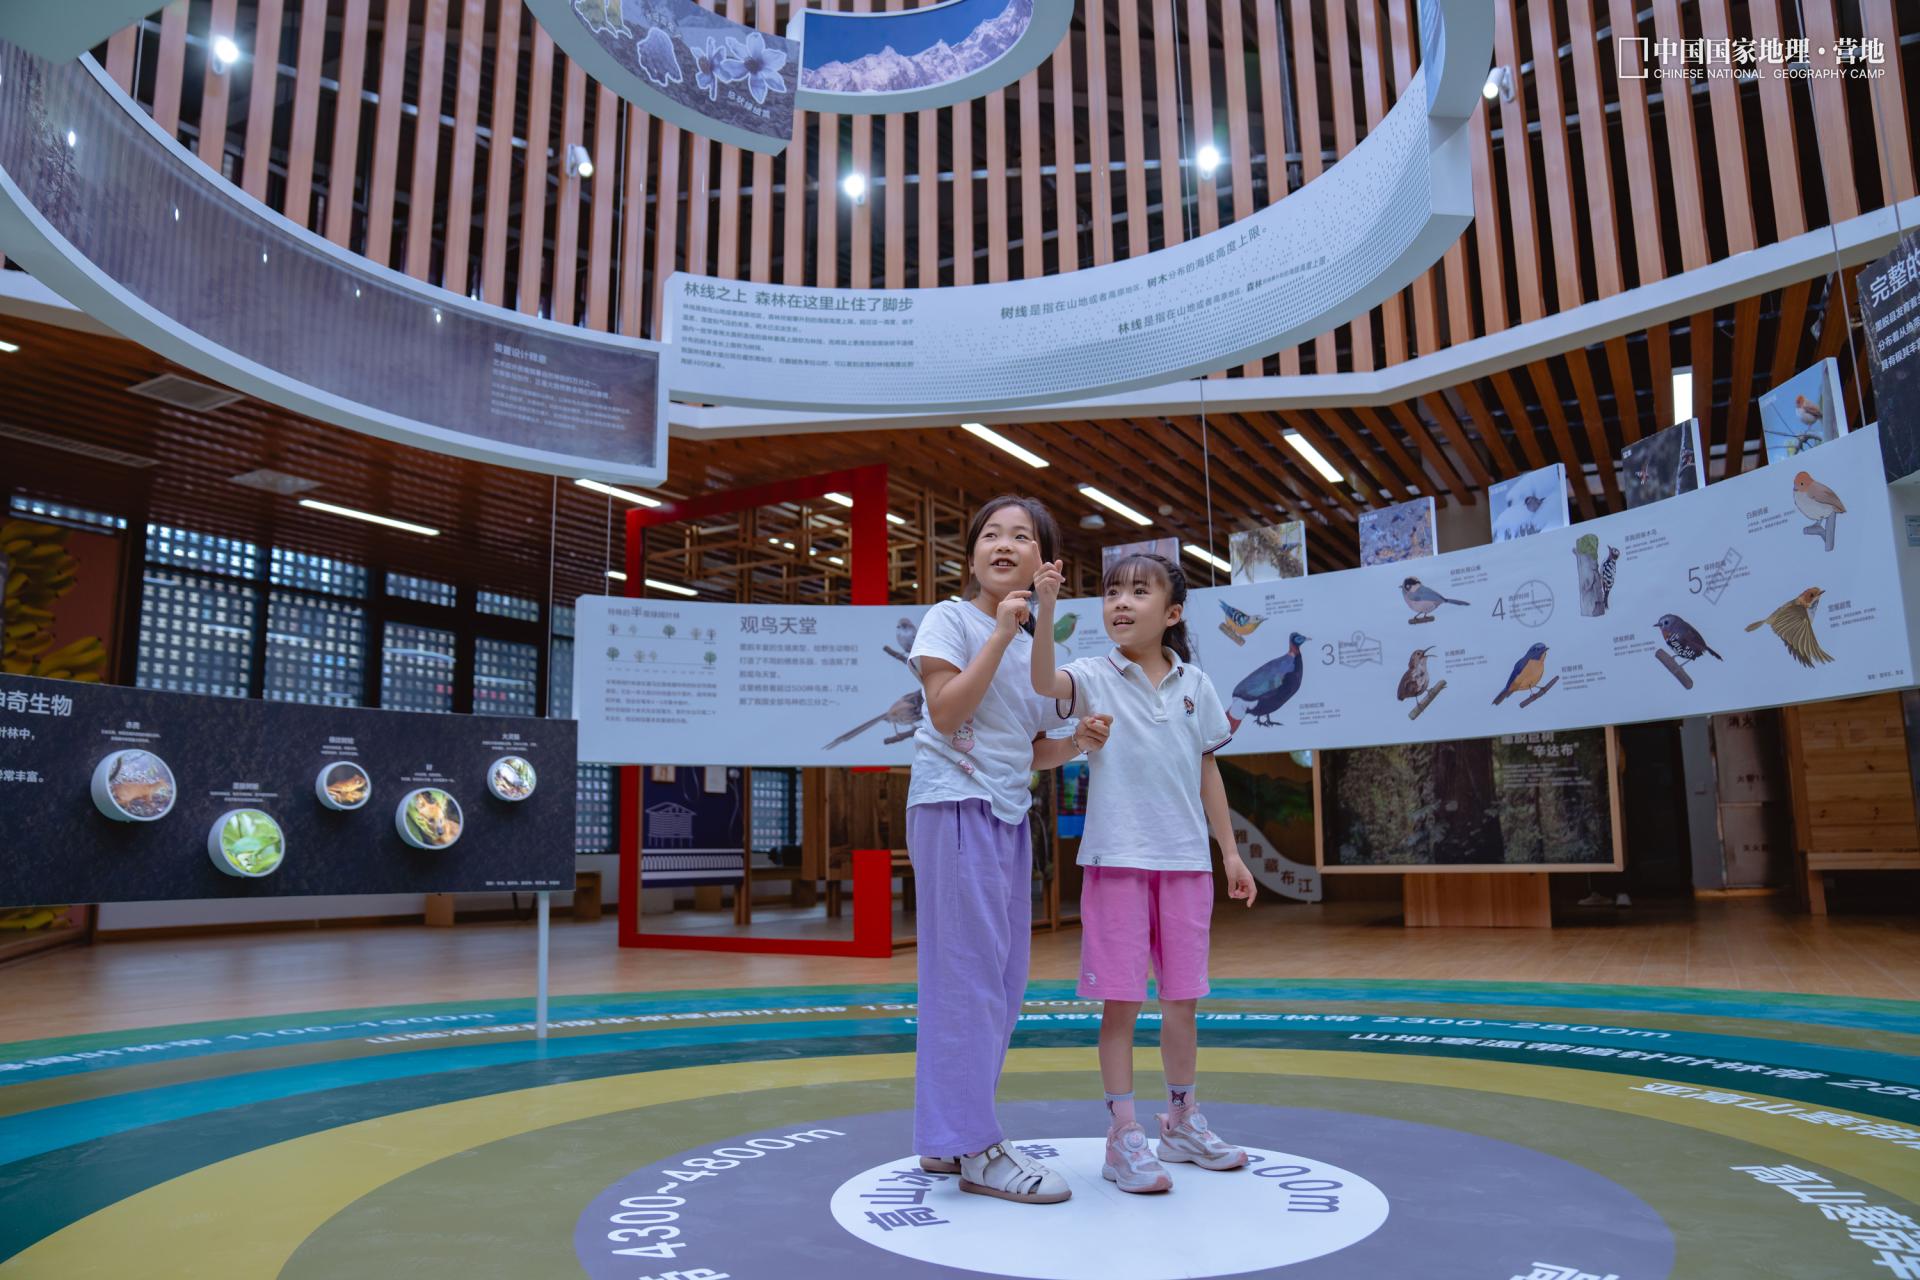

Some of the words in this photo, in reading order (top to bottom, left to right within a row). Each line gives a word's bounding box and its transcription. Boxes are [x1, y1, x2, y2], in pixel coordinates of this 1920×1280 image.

[684, 281, 747, 303] 林线之上
[754, 291, 914, 312] 森林在这里止住了脚步
[1688, 566, 1703, 594] 5
[1492, 597, 1505, 620] 4
[740, 615, 817, 635] 观鸟天堂
[1321, 644, 1335, 666] 3
[1349, 1033, 1829, 1080] 山地寒温带暗针叶林带
[607, 1128, 846, 1259] 4300~4800m
